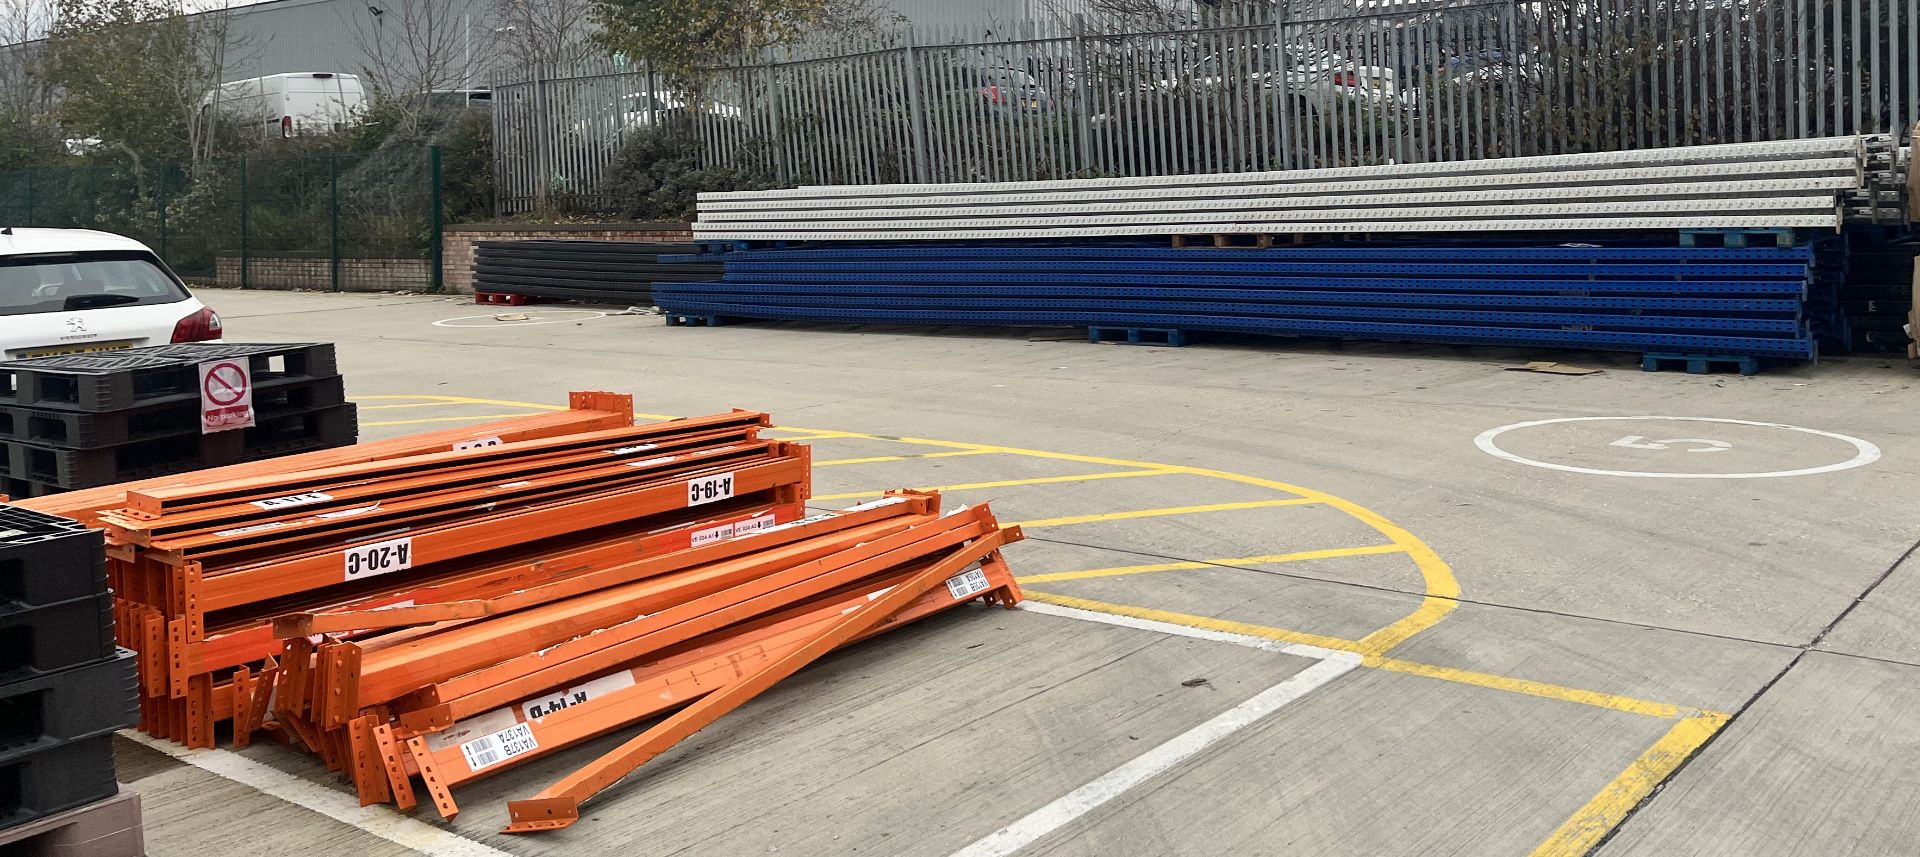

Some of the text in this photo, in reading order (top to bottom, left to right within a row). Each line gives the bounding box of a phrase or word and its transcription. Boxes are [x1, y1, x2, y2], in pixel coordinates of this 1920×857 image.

[220, 410, 249, 420] parking
[691, 477, 731, 502] A-19-C
[348, 542, 409, 575] A-20-C
[497, 724, 530, 743] VA137A
[503, 736, 536, 756] VA137B
